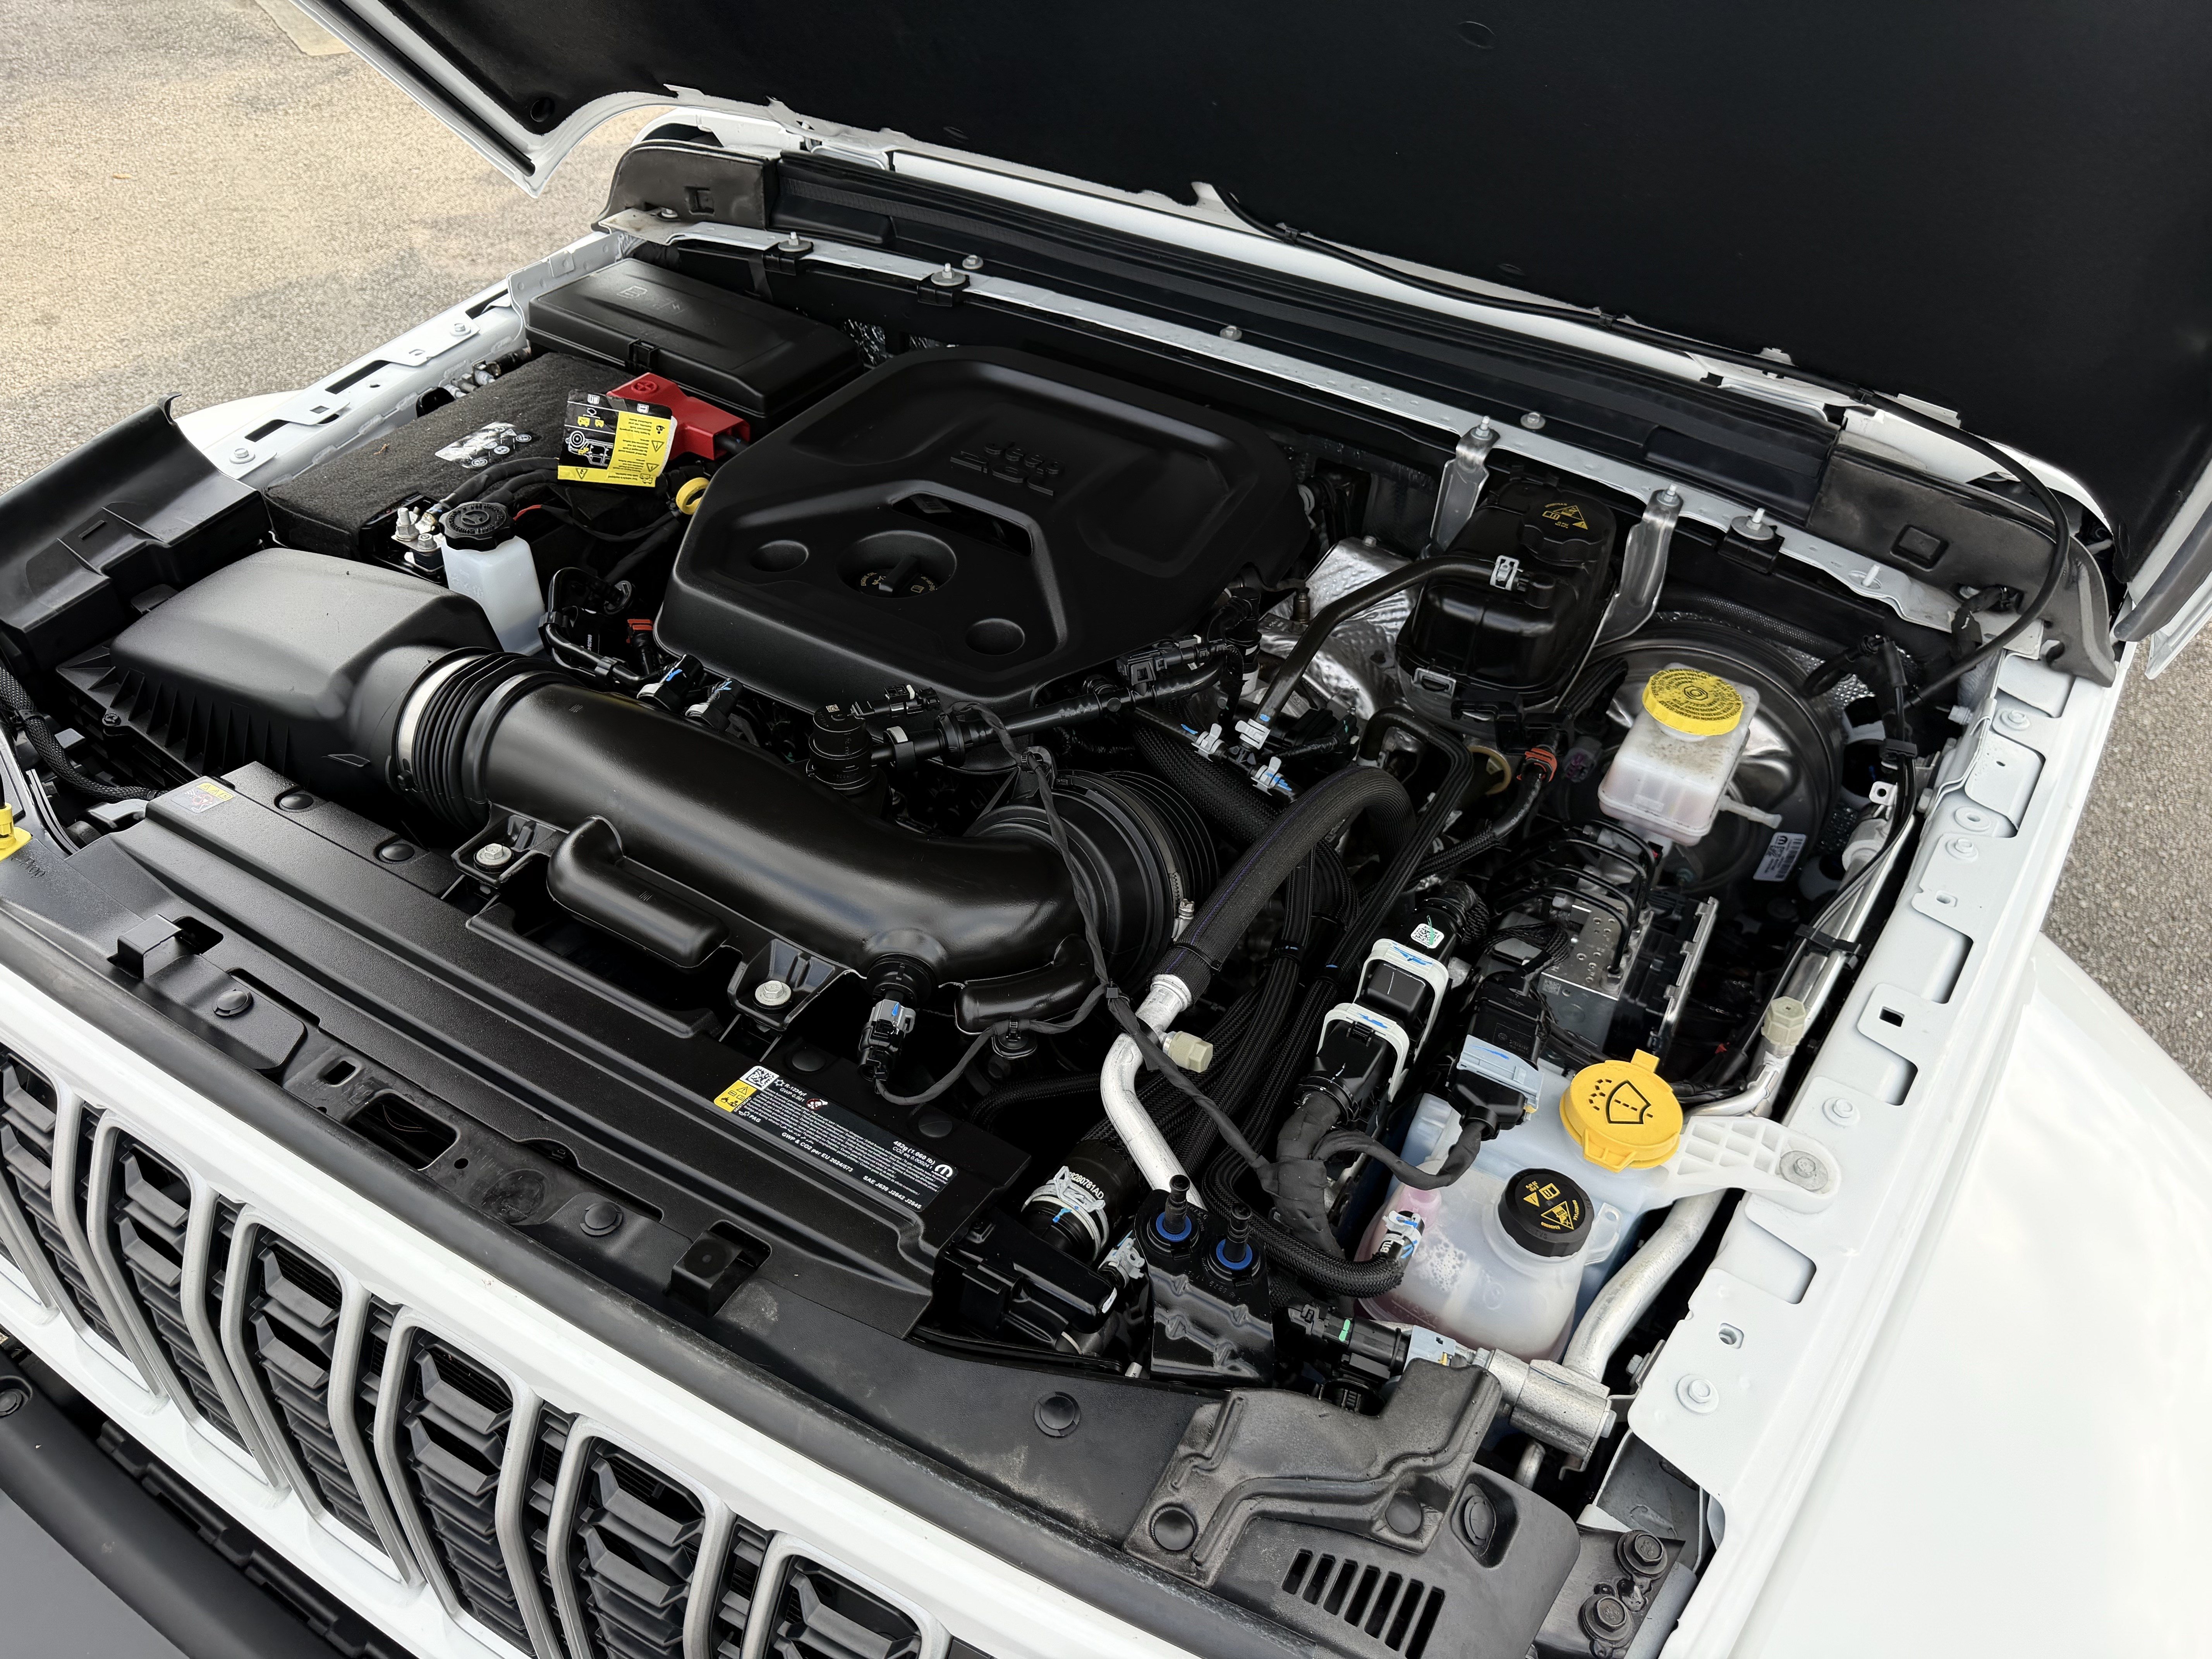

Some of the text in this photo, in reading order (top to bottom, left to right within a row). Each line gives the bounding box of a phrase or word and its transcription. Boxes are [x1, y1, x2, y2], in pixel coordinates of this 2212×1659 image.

[784, 1084, 807, 1096] R-1234yf
[749, 1115, 761, 1123] PAG
[781, 1132, 796, 1140] GWP
[800, 1142, 812, 1150] CO2
[829, 1158, 853, 1172] 2024/573
[892, 1146, 904, 1154] CO2
[910, 1156, 930, 1168] 0.00024
[893, 1141, 908, 1151] 482g
[907, 1148, 927, 1160] (1.060
[863, 1175, 922, 1209] SAE J639 J2842 J2845
[1069, 1171, 1105, 1200] 8280781AD
